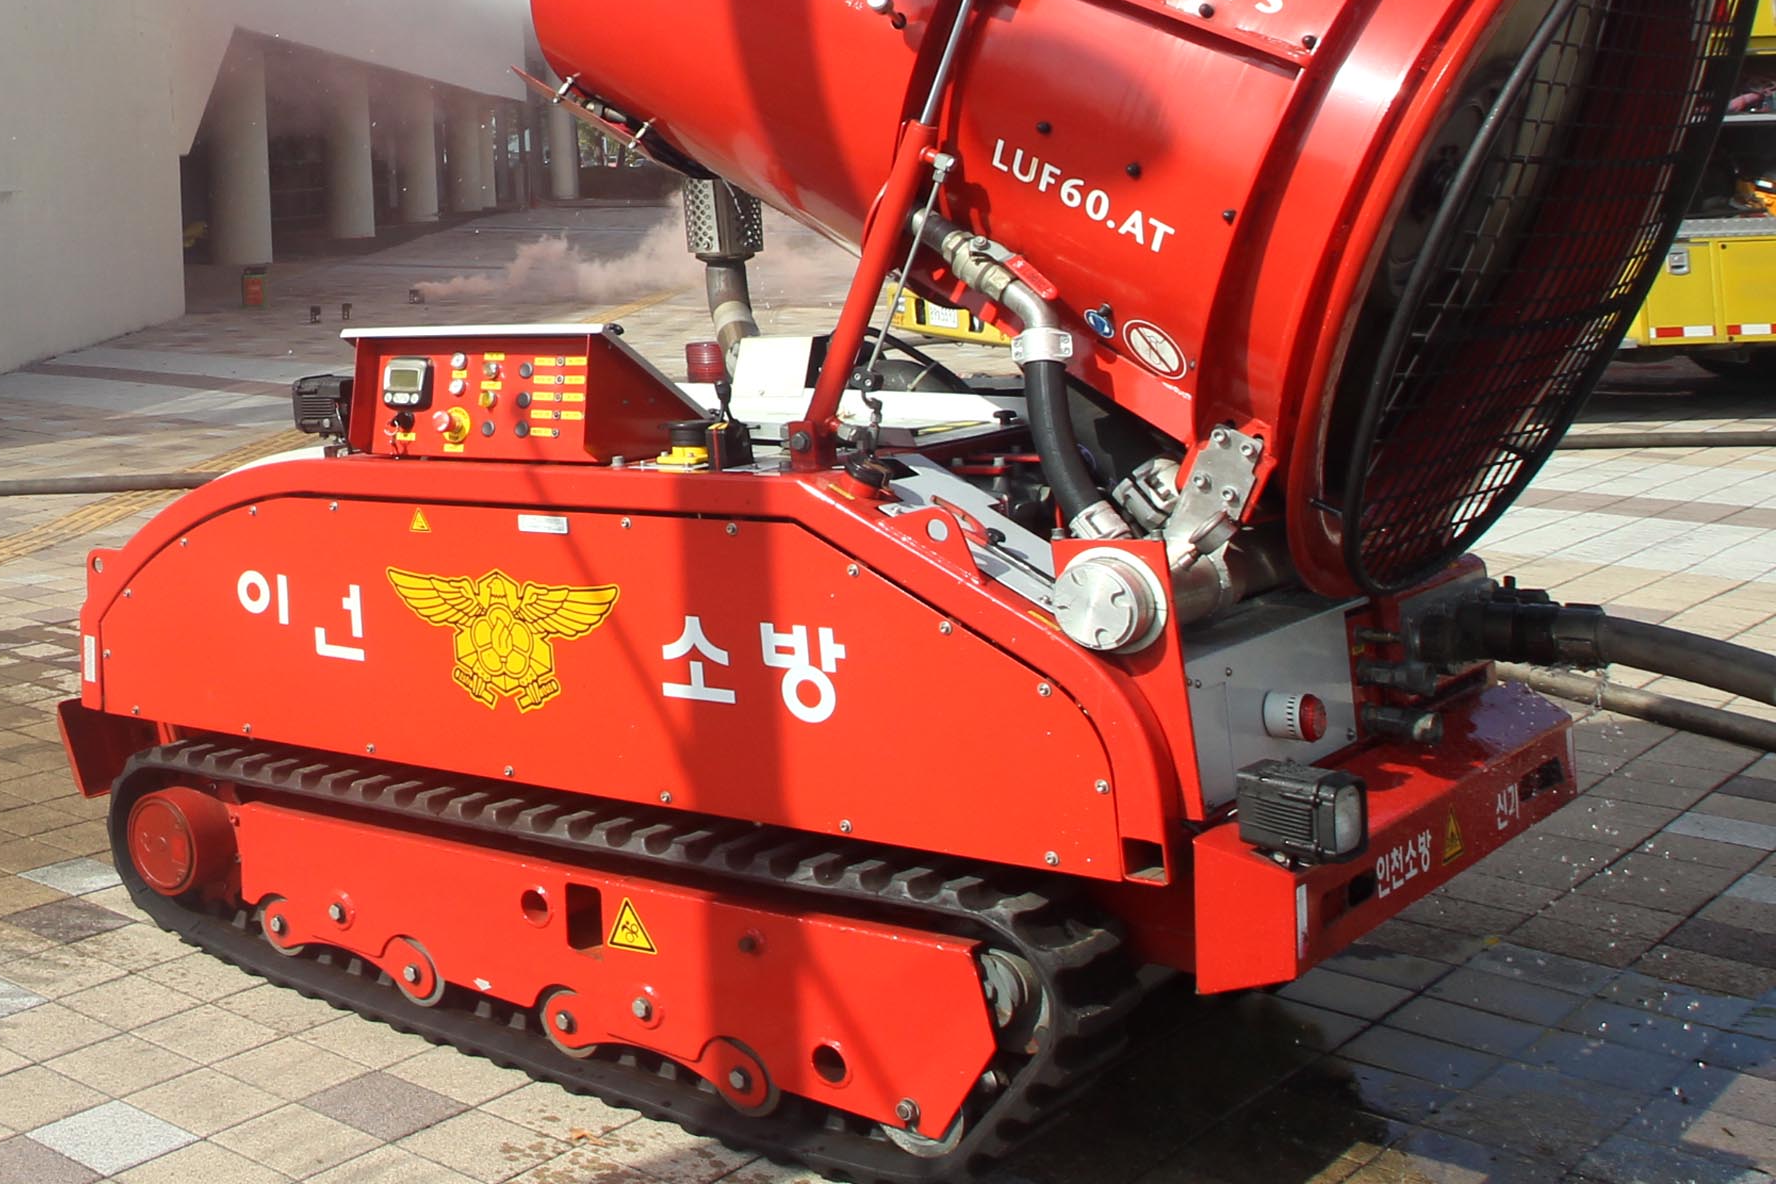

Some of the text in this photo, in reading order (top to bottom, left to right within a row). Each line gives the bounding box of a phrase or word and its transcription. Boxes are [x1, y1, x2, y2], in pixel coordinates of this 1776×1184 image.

[991, 137, 1176, 254] LUF60.AT
[661, 615, 846, 723] 소방
[1376, 829, 1432, 899] 인천소방
